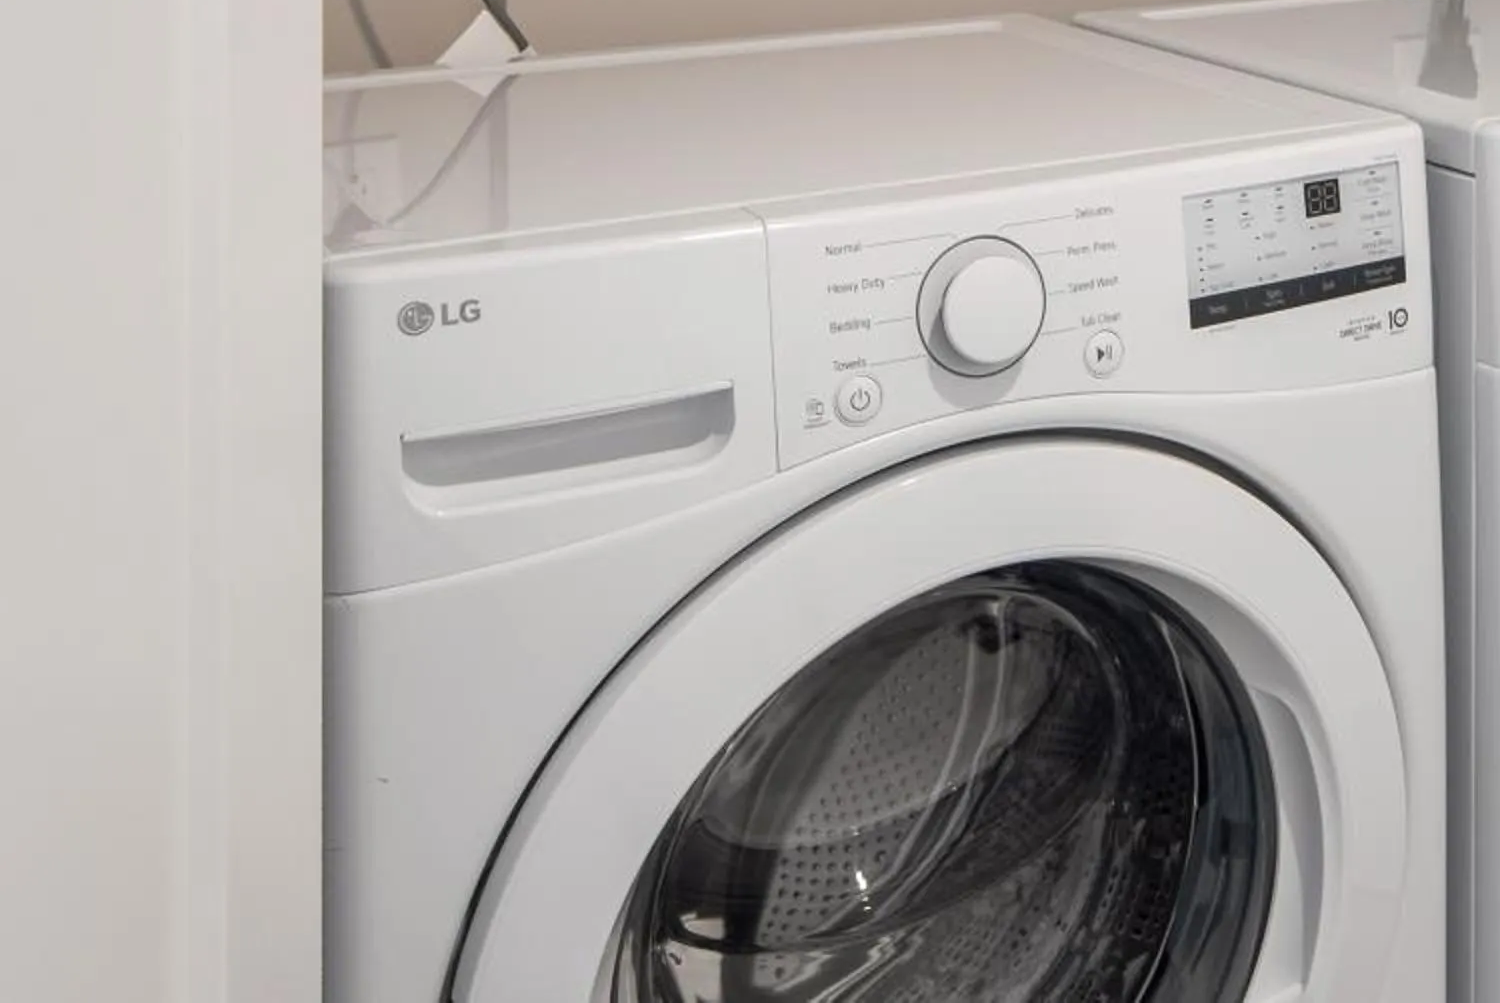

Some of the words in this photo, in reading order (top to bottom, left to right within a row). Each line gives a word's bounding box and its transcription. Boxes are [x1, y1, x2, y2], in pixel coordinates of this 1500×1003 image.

[825, 244, 861, 256] Normal
[827, 281, 858, 294] Heavy
[861, 277, 885, 290] Duty
[441, 299, 481, 326] LG
